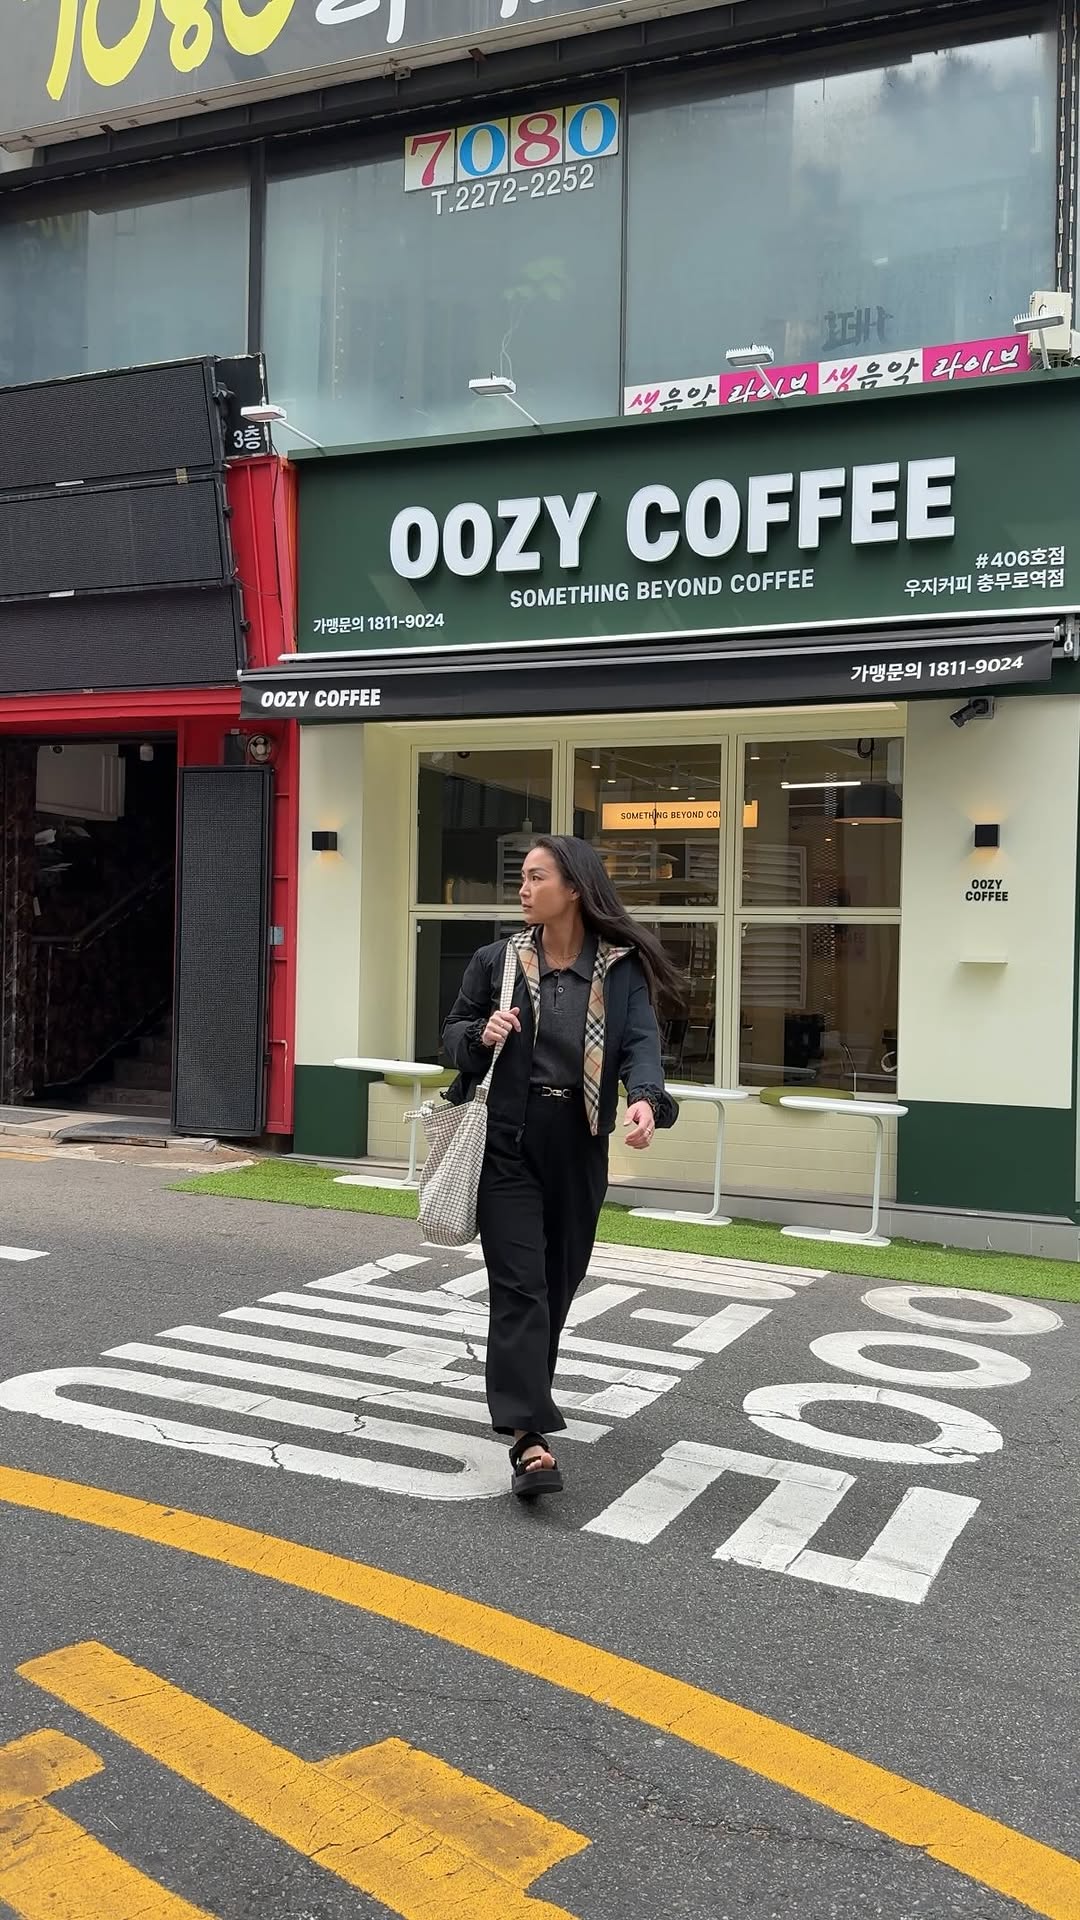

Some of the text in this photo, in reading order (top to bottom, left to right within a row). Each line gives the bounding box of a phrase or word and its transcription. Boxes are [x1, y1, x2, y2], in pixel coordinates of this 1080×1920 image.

[410, 103, 617, 187] 7080
[431, 163, 595, 215] T.2272-2252
[931, 343, 1020, 380] 라이브
[233, 425, 262, 450] 3층
[389, 456, 956, 580] OOZY COFFEE
[510, 568, 815, 609] SOMETHING BEYOND COFFEE
[904, 568, 1065, 598] 우지커피 충무로역점
[313, 613, 445, 635] 가맹문의 1811-9024
[850, 655, 1025, 683] 가맹문의 1811-9024
[261, 688, 381, 708] OOZY COFFEE
[670, 810, 704, 819] BEYOND
[965, 891, 1009, 902] COFFEE
[971, 879, 1003, 890] OOZY
